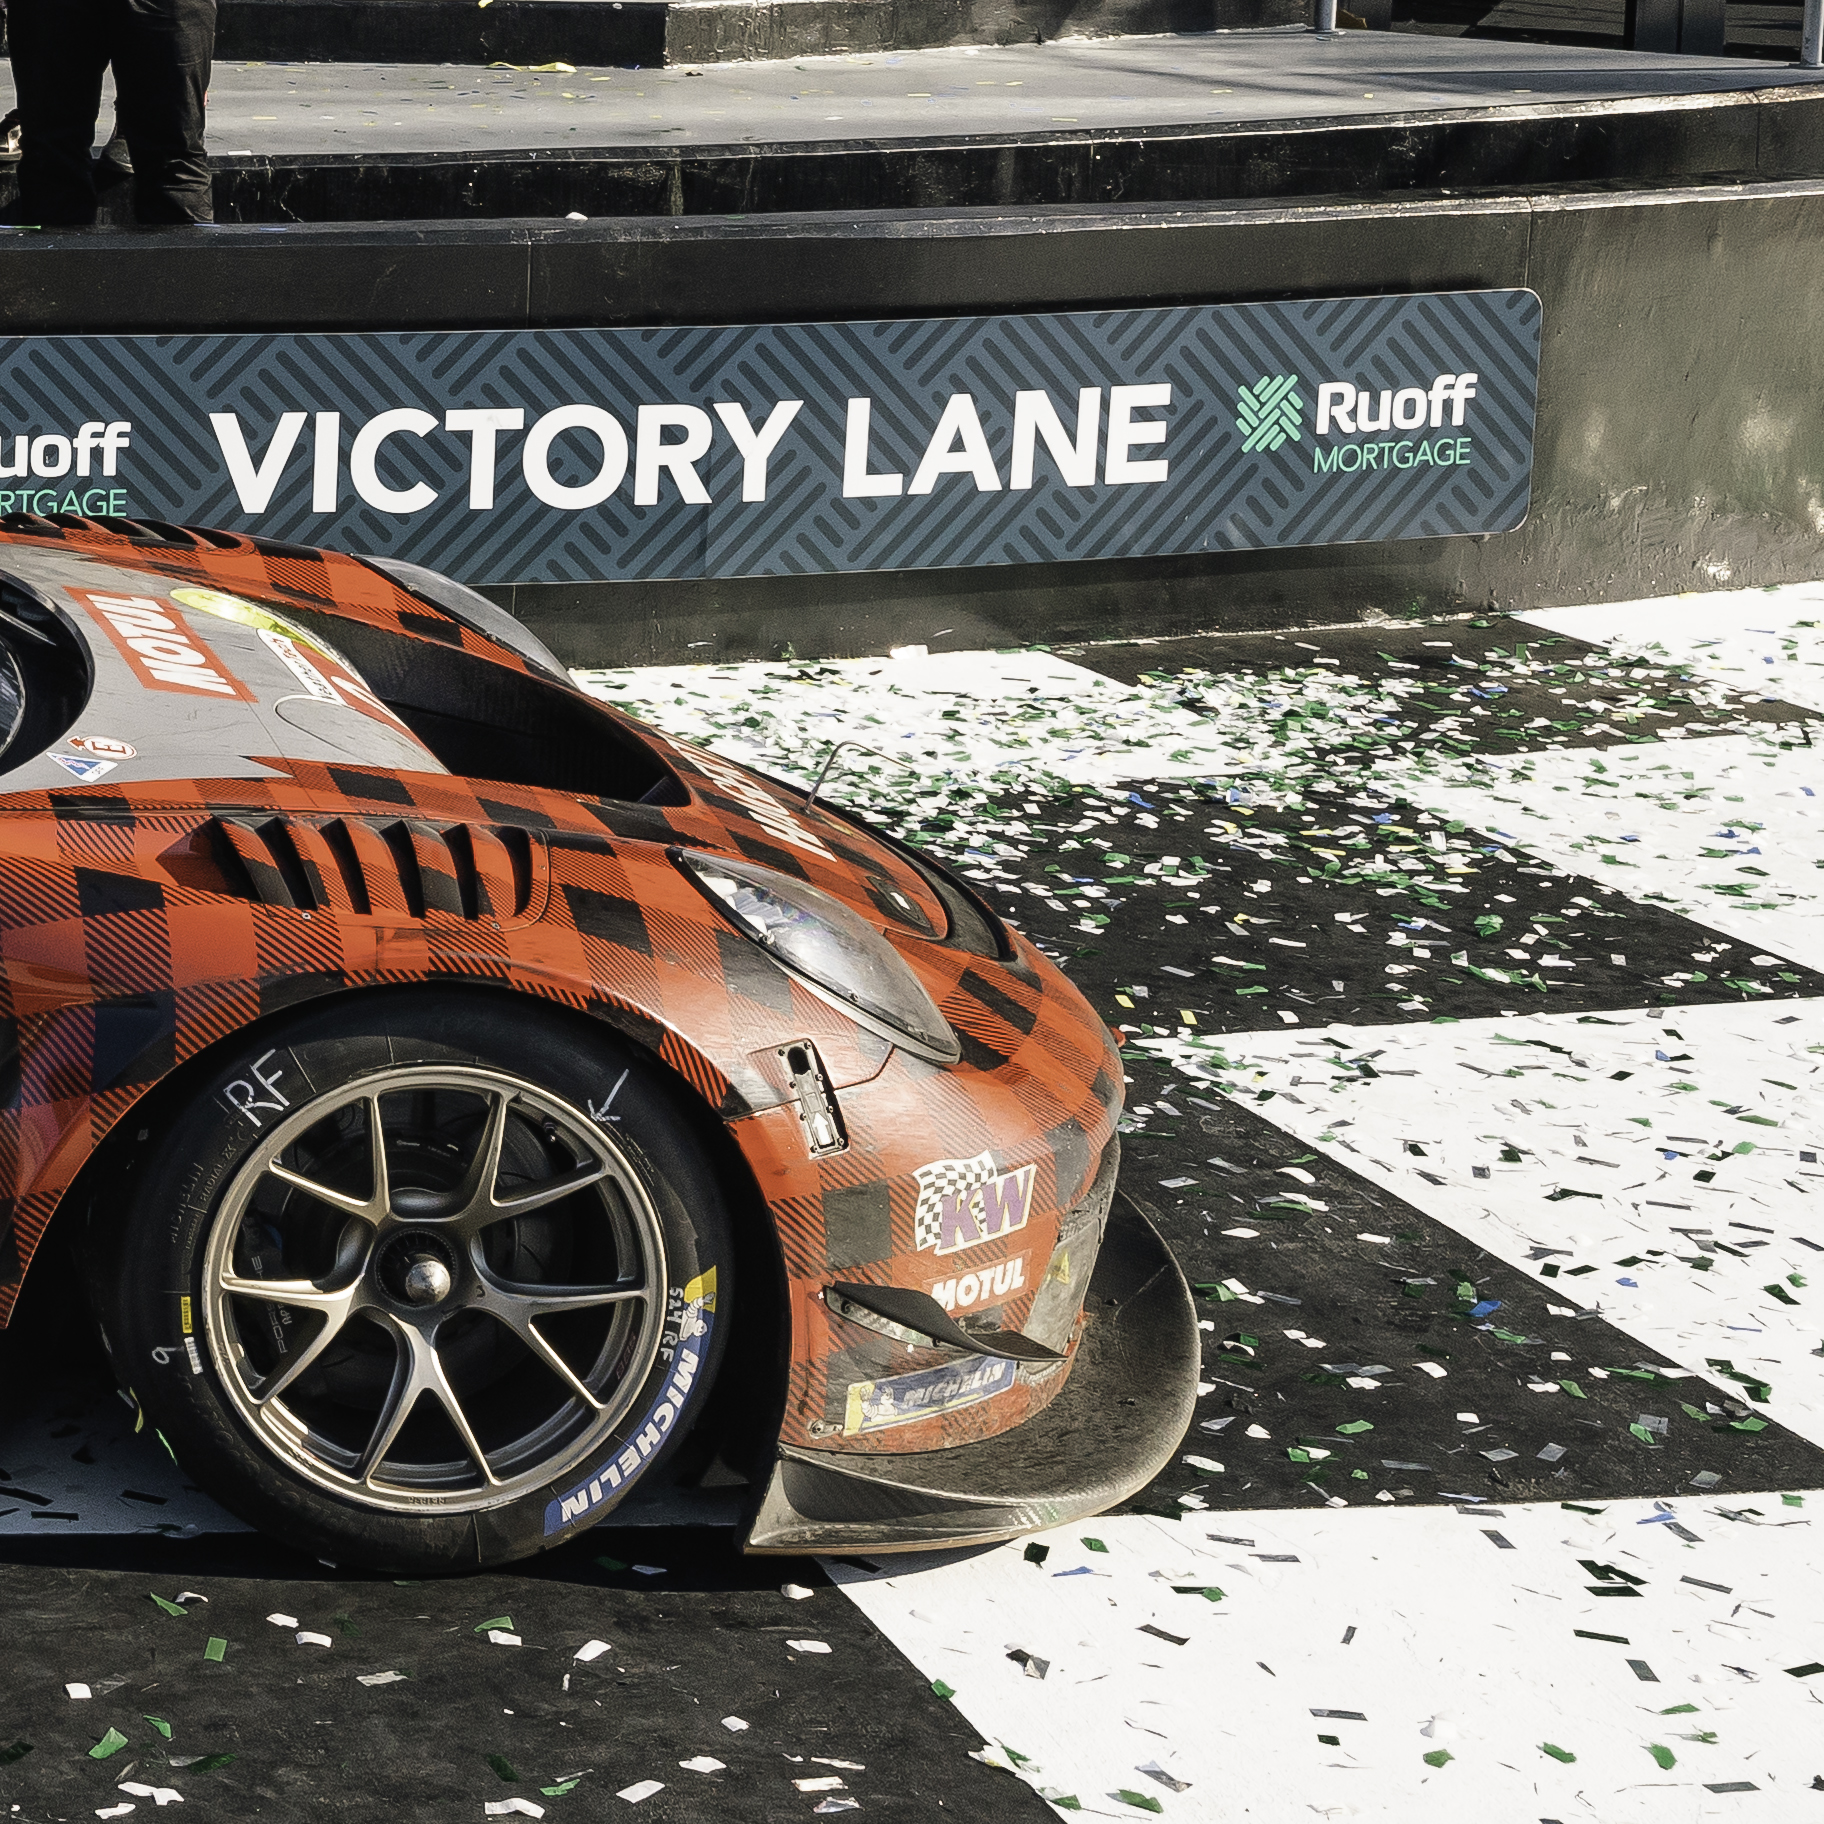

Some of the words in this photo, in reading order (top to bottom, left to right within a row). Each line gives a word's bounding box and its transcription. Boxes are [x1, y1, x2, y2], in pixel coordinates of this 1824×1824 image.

[1315, 373, 1478, 435] Ruoff
[209, 398, 804, 514] VICTORY
[842, 383, 1172, 499] LANE
[1313, 437, 1472, 475] MORTGAGE
[85, 593, 239, 696] MOTUL
[223, 1049, 290, 1128] RF
[937, 1166, 1034, 1251] KW
[931, 1257, 1026, 1312] MOTUL
[903, 1361, 1007, 1409] MICHELIN
[561, 1348, 700, 1523] MICHELIN
